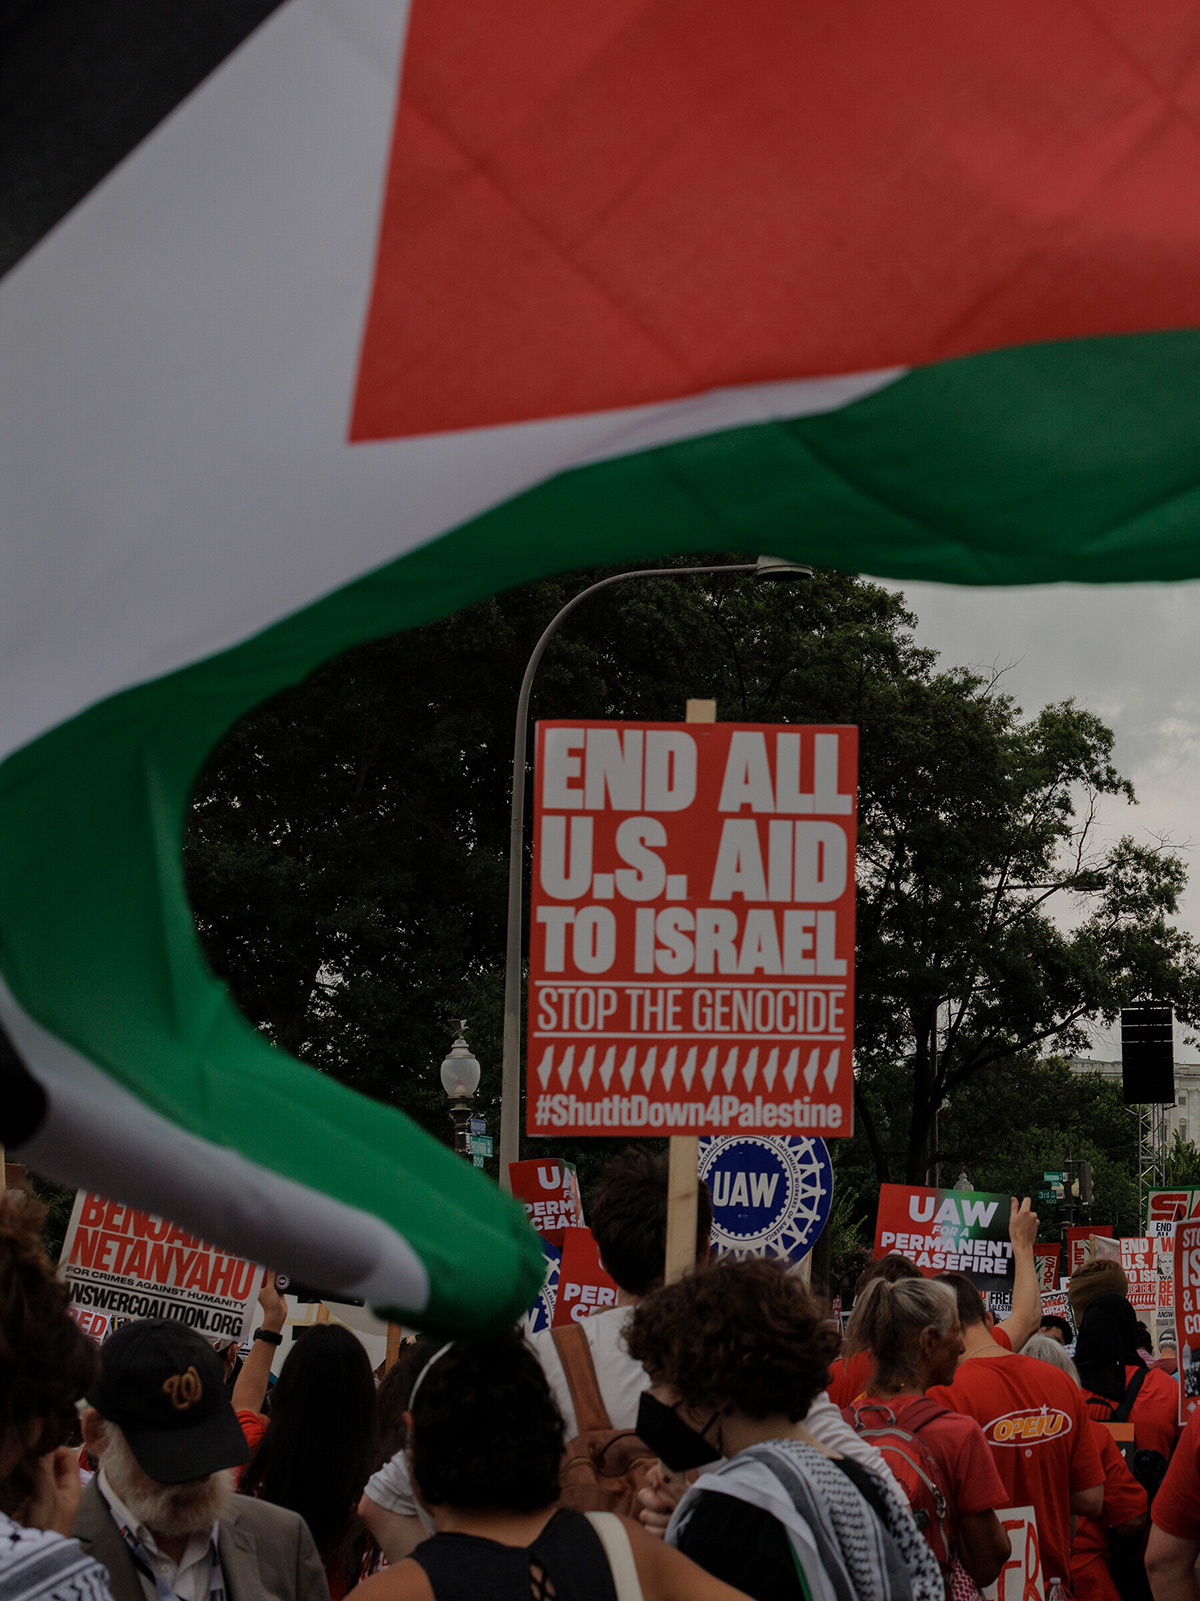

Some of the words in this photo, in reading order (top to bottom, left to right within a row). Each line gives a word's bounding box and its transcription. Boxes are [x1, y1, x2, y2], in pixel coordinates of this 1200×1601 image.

[542, 728, 697, 812] END
[718, 731, 853, 815] ALL
[540, 815, 688, 902] U.S.
[709, 819, 847, 903] AID
[536, 906, 616, 974] TO
[634, 907, 847, 976] ISRAEL
[537, 988, 618, 1031] STOP
[626, 989, 683, 1031] THE
[692, 989, 845, 1033] GENOCIDE
[535, 1094, 842, 1128] #ShutItDown4Palestine
[777, 1142, 799, 1174] IMPLEMENT
[713, 1171, 780, 1208] UAW
[790, 1177, 801, 1209] WORKERS
[787, 1210, 794, 1220] OF
[909, 1195, 999, 1228] UAW
[765, 1221, 787, 1242] AMERICA
[931, 1225, 958, 1236] FOR
[959, 1228, 969, 1237] A
[1156, 1223, 1172, 1232] END
[881, 1232, 1012, 1258] PERMANENT
[1121, 1239, 1149, 1253] END
[69, 1227, 257, 1300] NETANYAHU
[1044, 1257, 1055, 1286] STOP
[1122, 1254, 1149, 1269] U.S.
[1140, 1270, 1157, 1282] ISR
[66, 1265, 89, 1277] FOR
[92, 1271, 134, 1287] CRIMES
[136, 1281, 186, 1297] AGAINST
[187, 1290, 247, 1310] HUMANITY
[1183, 1290, 1194, 1312] &
[990, 1304, 1012, 1312] ALESTIN
[993, 1414, 1064, 1442] OPEIU
